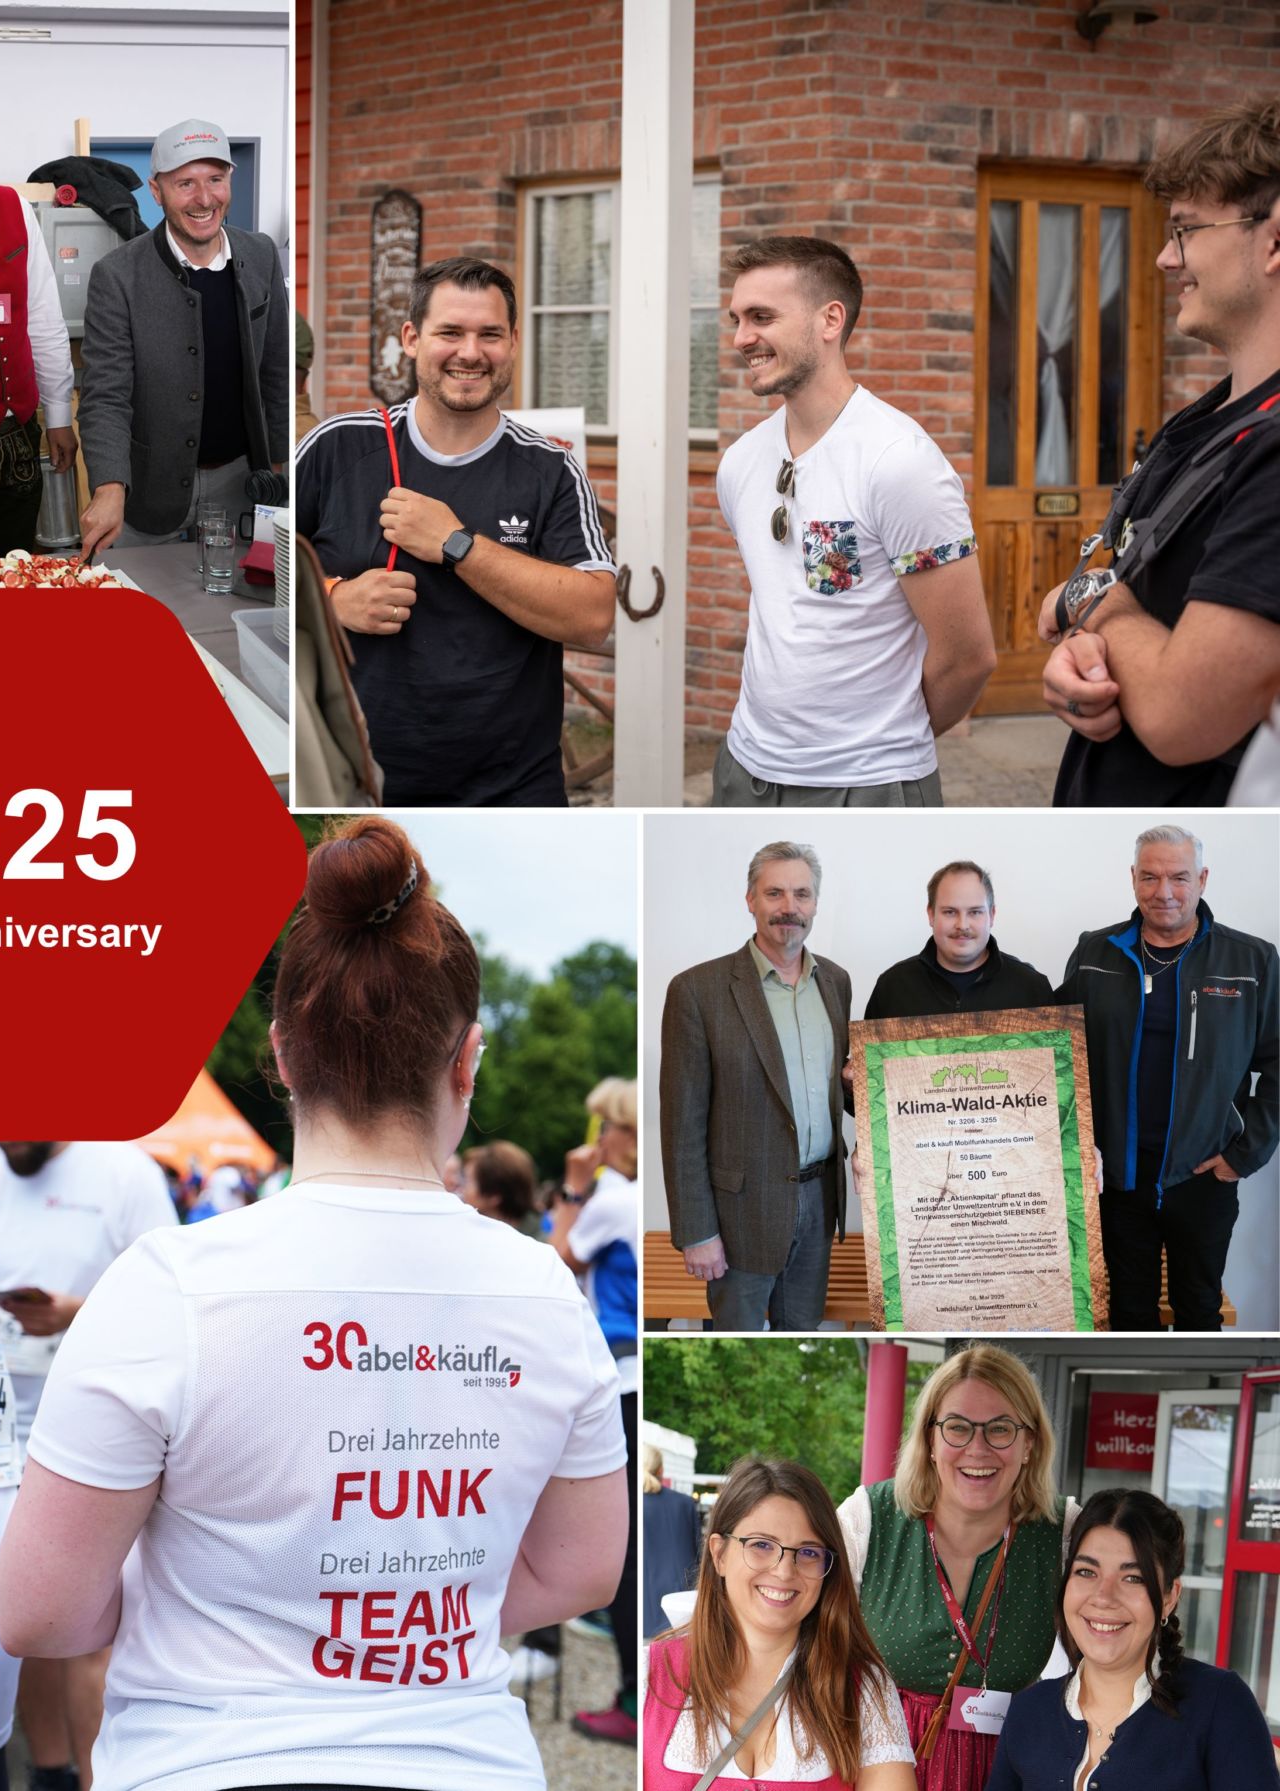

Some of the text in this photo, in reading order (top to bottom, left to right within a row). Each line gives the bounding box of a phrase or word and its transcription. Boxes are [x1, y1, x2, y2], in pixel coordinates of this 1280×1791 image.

[500, 536, 527, 544] adidas
[897, 1092, 1048, 1115] Klima-Wald-Aktie
[948, 1172, 962, 1180] über
[968, 1170, 986, 1180] 500
[952, 1202, 1008, 1210] Umweltzentrum
[1001, 1192, 1026, 1200] pflanzt
[1004, 1208, 1046, 1216] SIEBENSEE
[303, 1321, 497, 1372] 30 abel&käufl
[463, 1377, 508, 1388] seit 1995
[328, 1426, 500, 1452] Drei Jahrzehnte
[332, 1468, 494, 1521] FUNK
[320, 1546, 486, 1574] Drei Jahrzehnte
[318, 1581, 472, 1640] TEAM
[312, 1630, 477, 1686] GEIST
